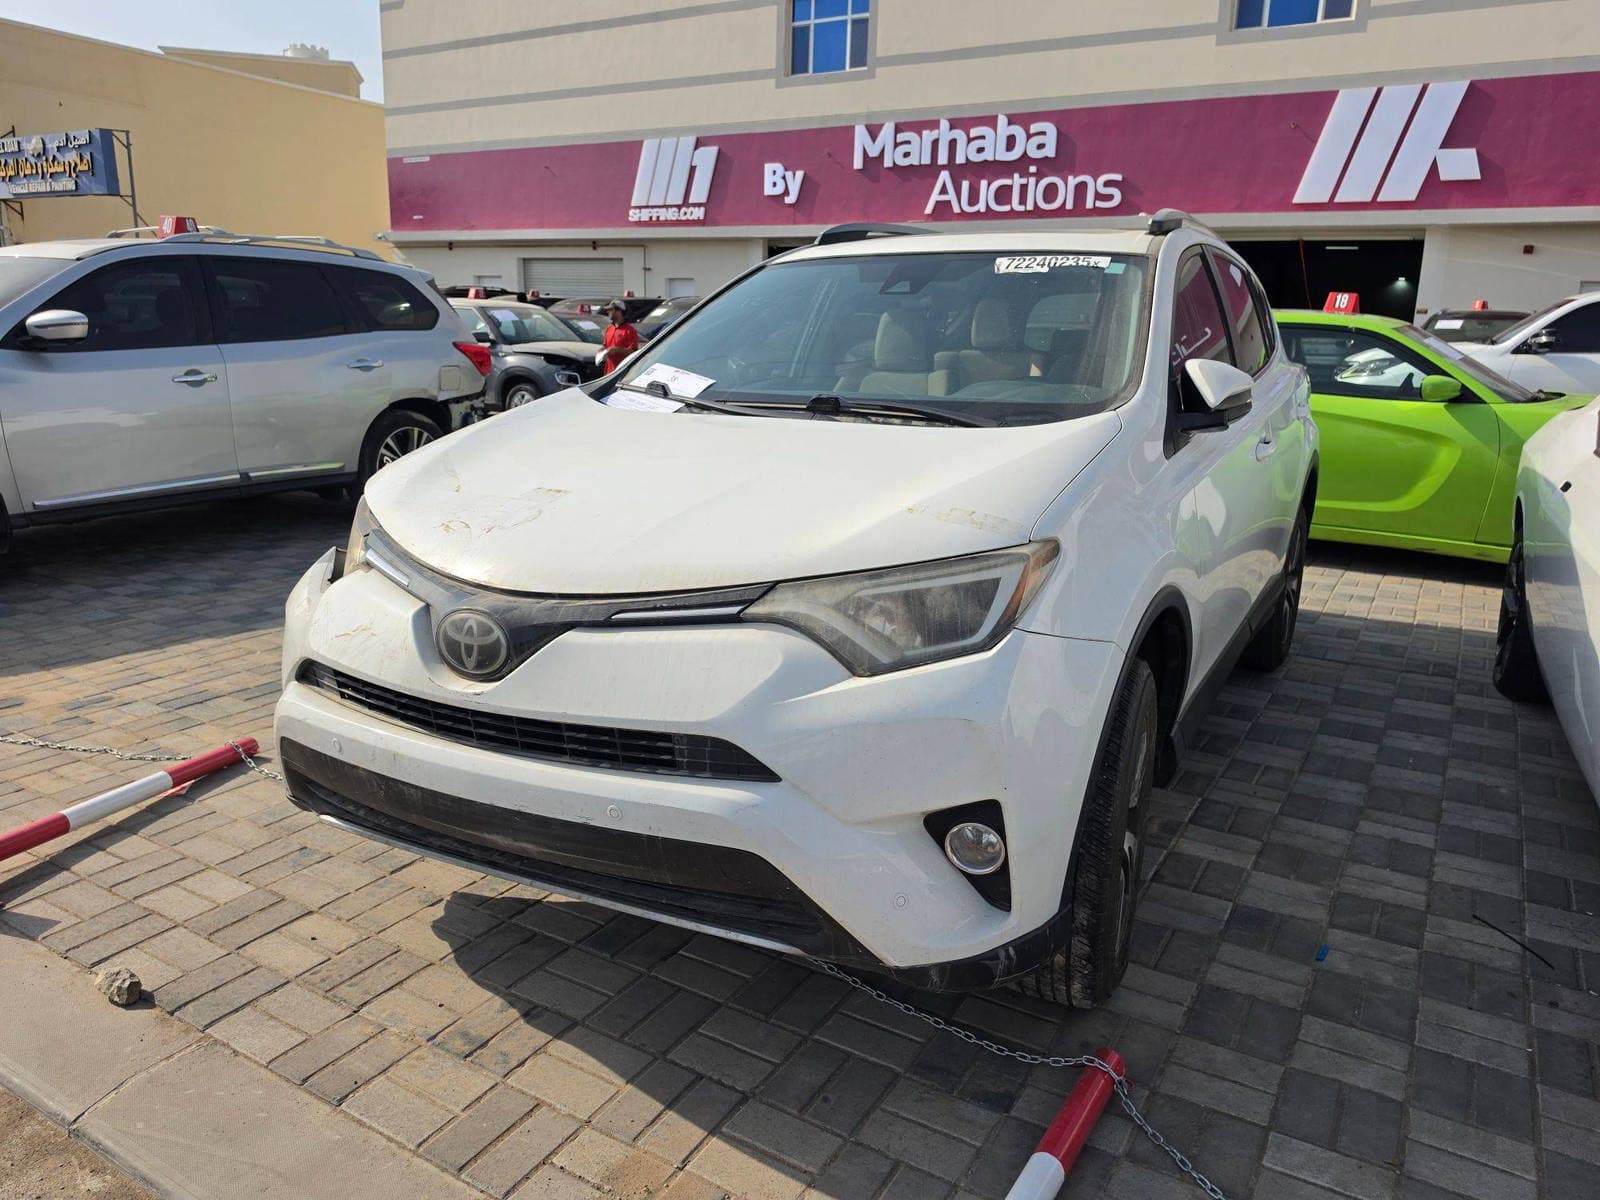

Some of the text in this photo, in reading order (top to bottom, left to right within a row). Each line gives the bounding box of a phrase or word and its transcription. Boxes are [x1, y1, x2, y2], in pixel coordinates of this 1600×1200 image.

[854, 114, 1058, 170] Marhaba
[764, 163, 805, 204] By
[924, 166, 1123, 215] Auctions
[629, 207, 705, 222] SHIPPING.COM
[1335, 293, 1349, 309] 18
